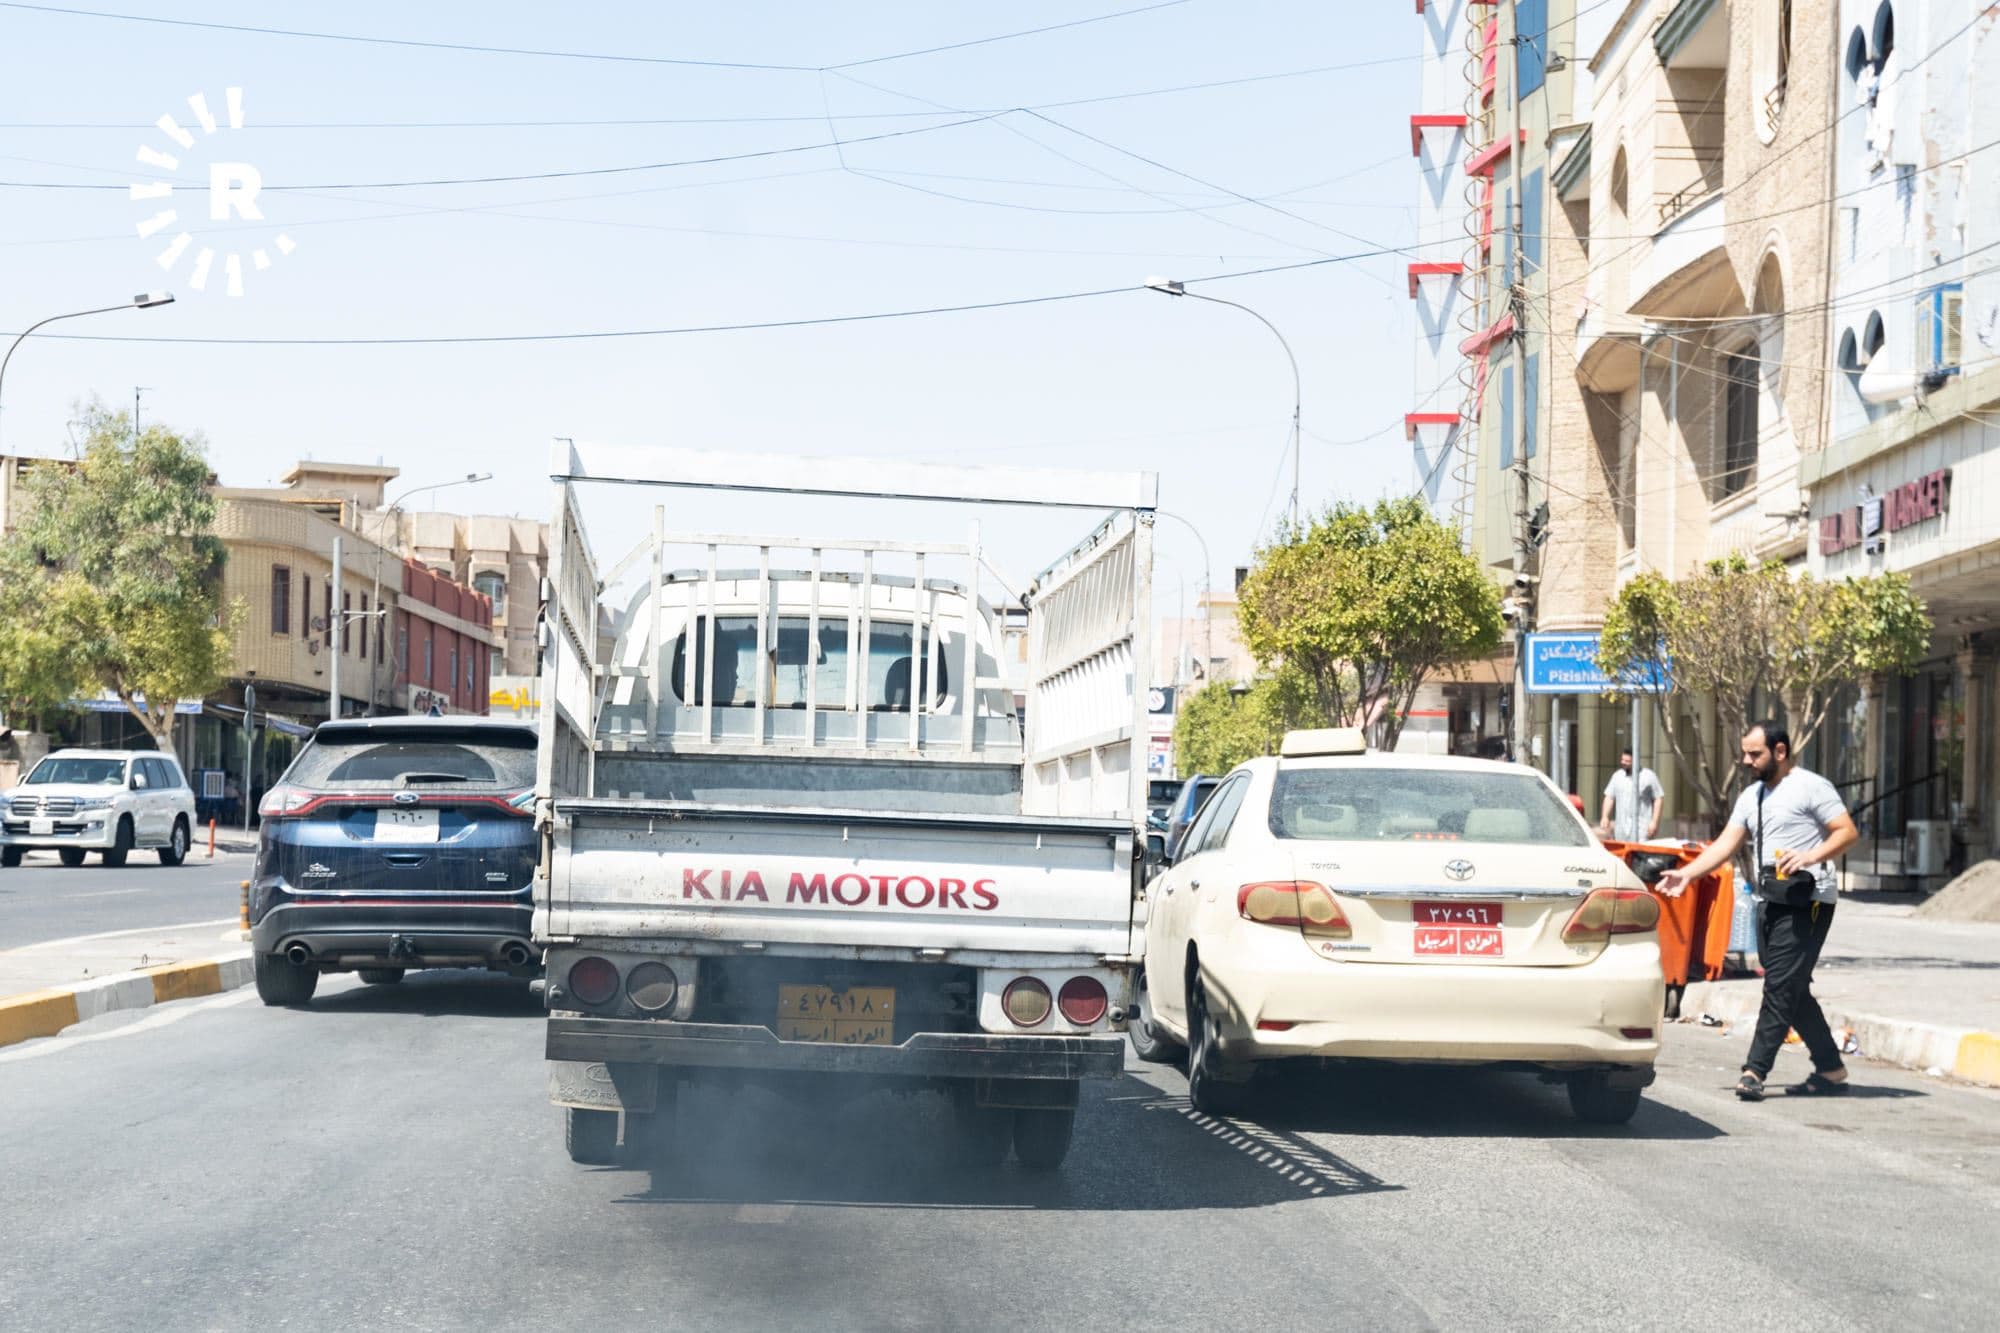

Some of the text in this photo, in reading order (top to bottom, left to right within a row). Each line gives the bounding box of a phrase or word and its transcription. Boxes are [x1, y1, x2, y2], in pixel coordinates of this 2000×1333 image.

[1883, 469, 1947, 533] MARKET
[392, 812, 423, 823] ٦٠٦٠
[1311, 862, 1341, 870] TOYOTA
[682, 868, 1000, 911] KIA MOTORS
[1429, 908, 1489, 924] ٣٧٠٩٦
[799, 992, 873, 1014] ٤٧٩١٨
